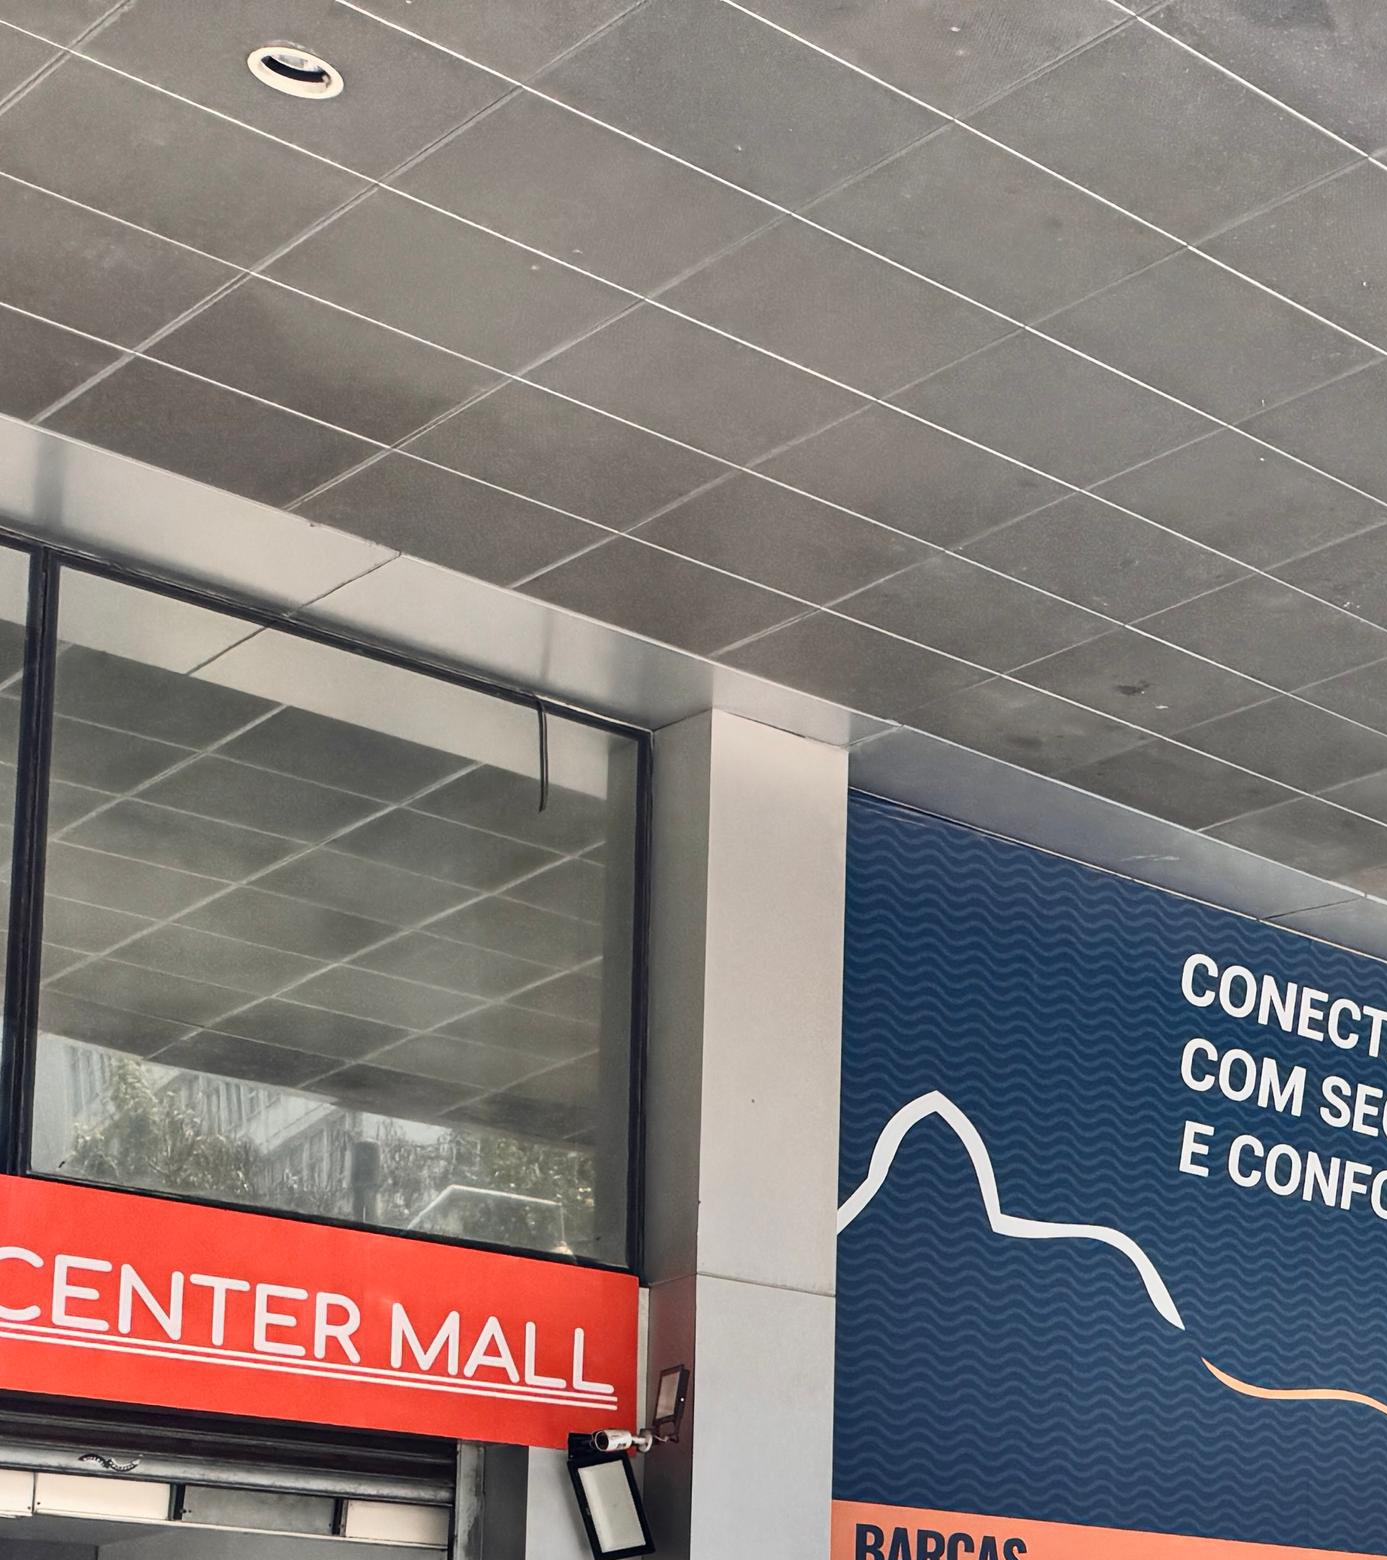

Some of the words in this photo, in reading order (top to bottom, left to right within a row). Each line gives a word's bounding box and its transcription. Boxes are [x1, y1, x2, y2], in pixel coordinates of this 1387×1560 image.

[1180, 1038, 1307, 1117] COM
[1179, 1120, 1215, 1177] E
[0, 1246, 361, 1364] CENTER
[391, 1303, 615, 1394] MALL
